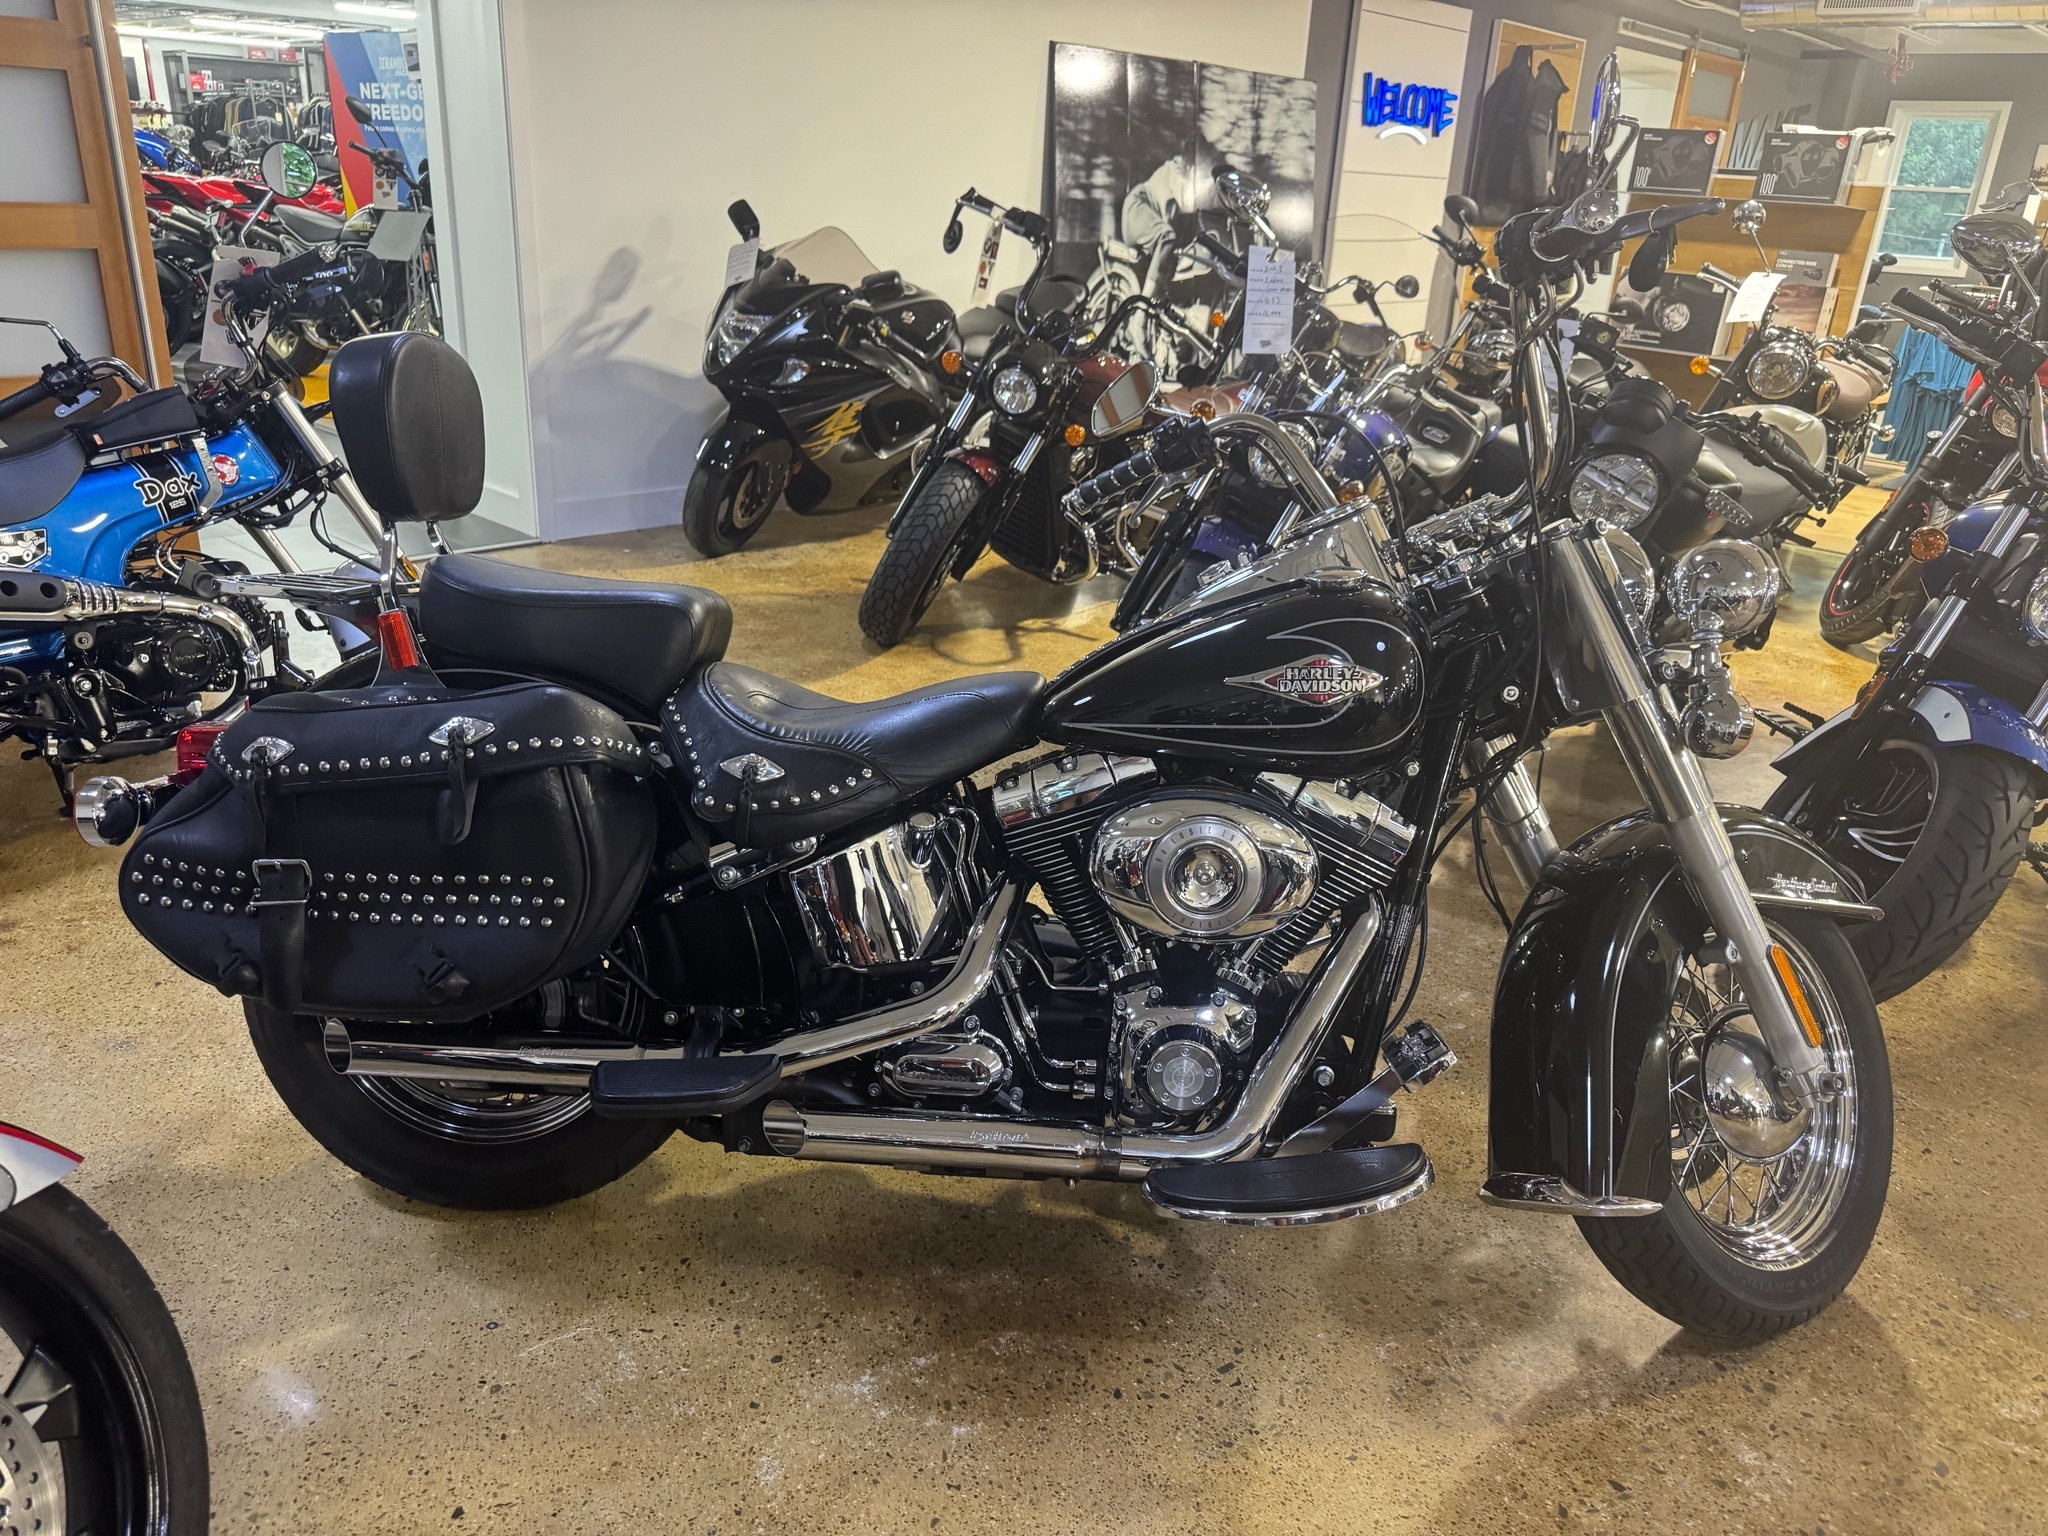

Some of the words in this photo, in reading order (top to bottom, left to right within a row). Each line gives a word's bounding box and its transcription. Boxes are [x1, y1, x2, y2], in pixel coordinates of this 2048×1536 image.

[359, 82, 424, 100] NEXT-GE
[366, 103, 424, 122] REEDO
[1361, 72, 1458, 138] WELCOME
[133, 471, 202, 508] Dax
[168, 497, 187, 509] 125
[1278, 679, 1364, 693] DAVIDSON
